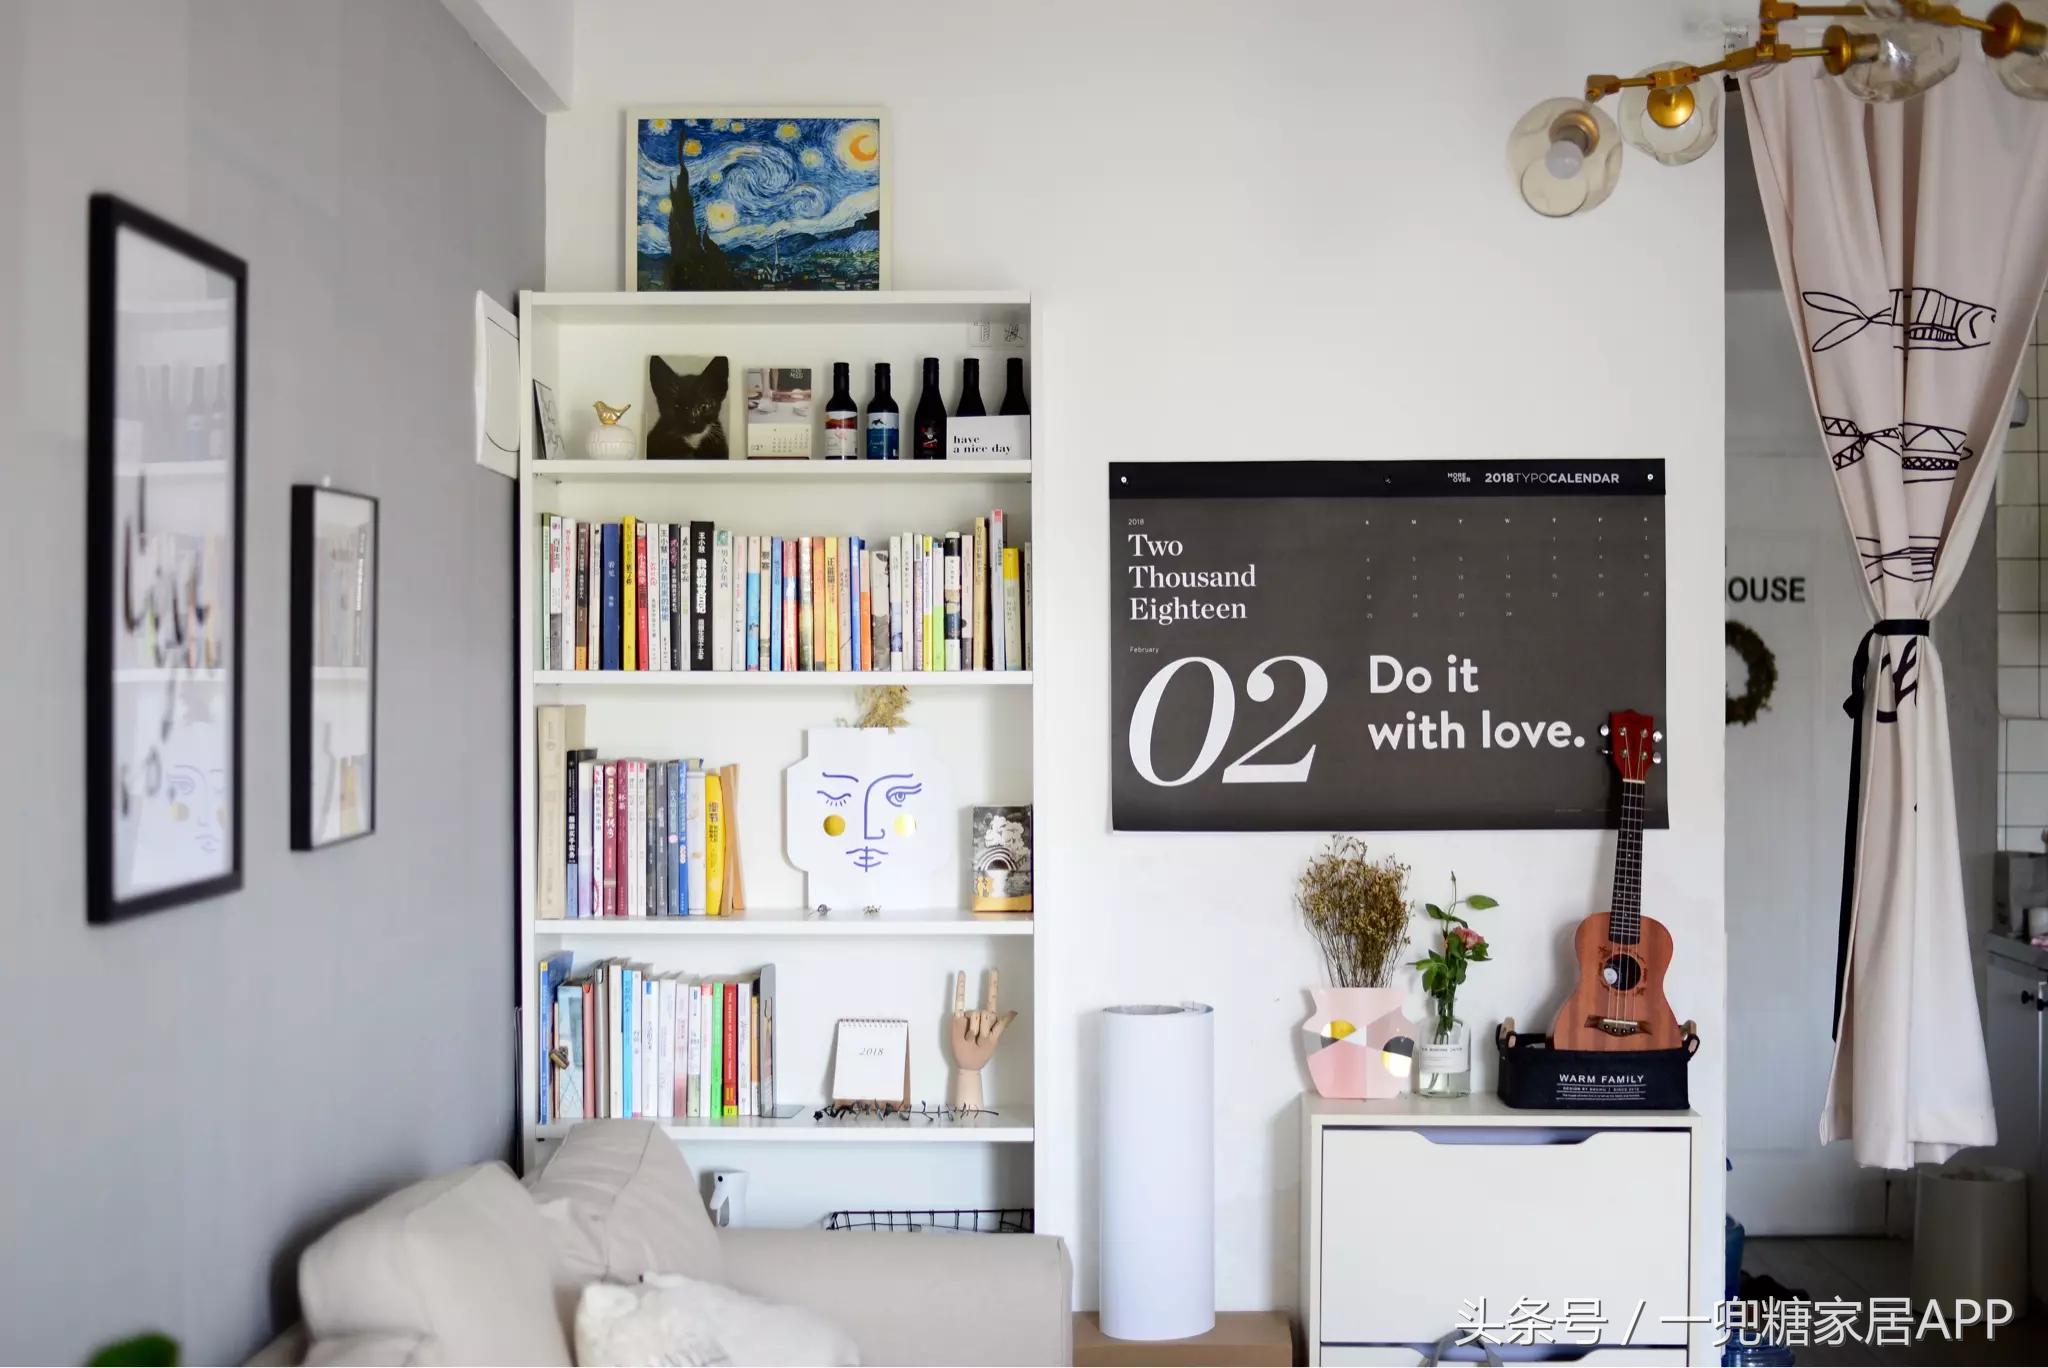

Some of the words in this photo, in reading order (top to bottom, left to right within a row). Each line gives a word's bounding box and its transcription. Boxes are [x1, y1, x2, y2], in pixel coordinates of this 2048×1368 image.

[953, 435, 980, 444] have
[953, 446, 960, 454] a
[964, 444, 988, 453] nice
[991, 444, 1011, 455] day
[1484, 472, 1620, 484] 2018TYPOCALENDAR
[1128, 518, 1145, 526] 2018
[1127, 533, 1184, 557] Two
[1128, 563, 1257, 588] Thousand
[1725, 576, 1806, 602] OUSE
[1129, 596, 1248, 626] Eighteen
[1369, 655, 1432, 694] Do
[1447, 654, 1479, 693] it
[1128, 655, 1328, 787] 02
[1367, 710, 1465, 750] with
[1482, 709, 1586, 749] love.
[858, 1047, 885, 1056] 2018
[1559, 1074, 1596, 1083] WARM
[1601, 1074, 1644, 1084] FAMILY
